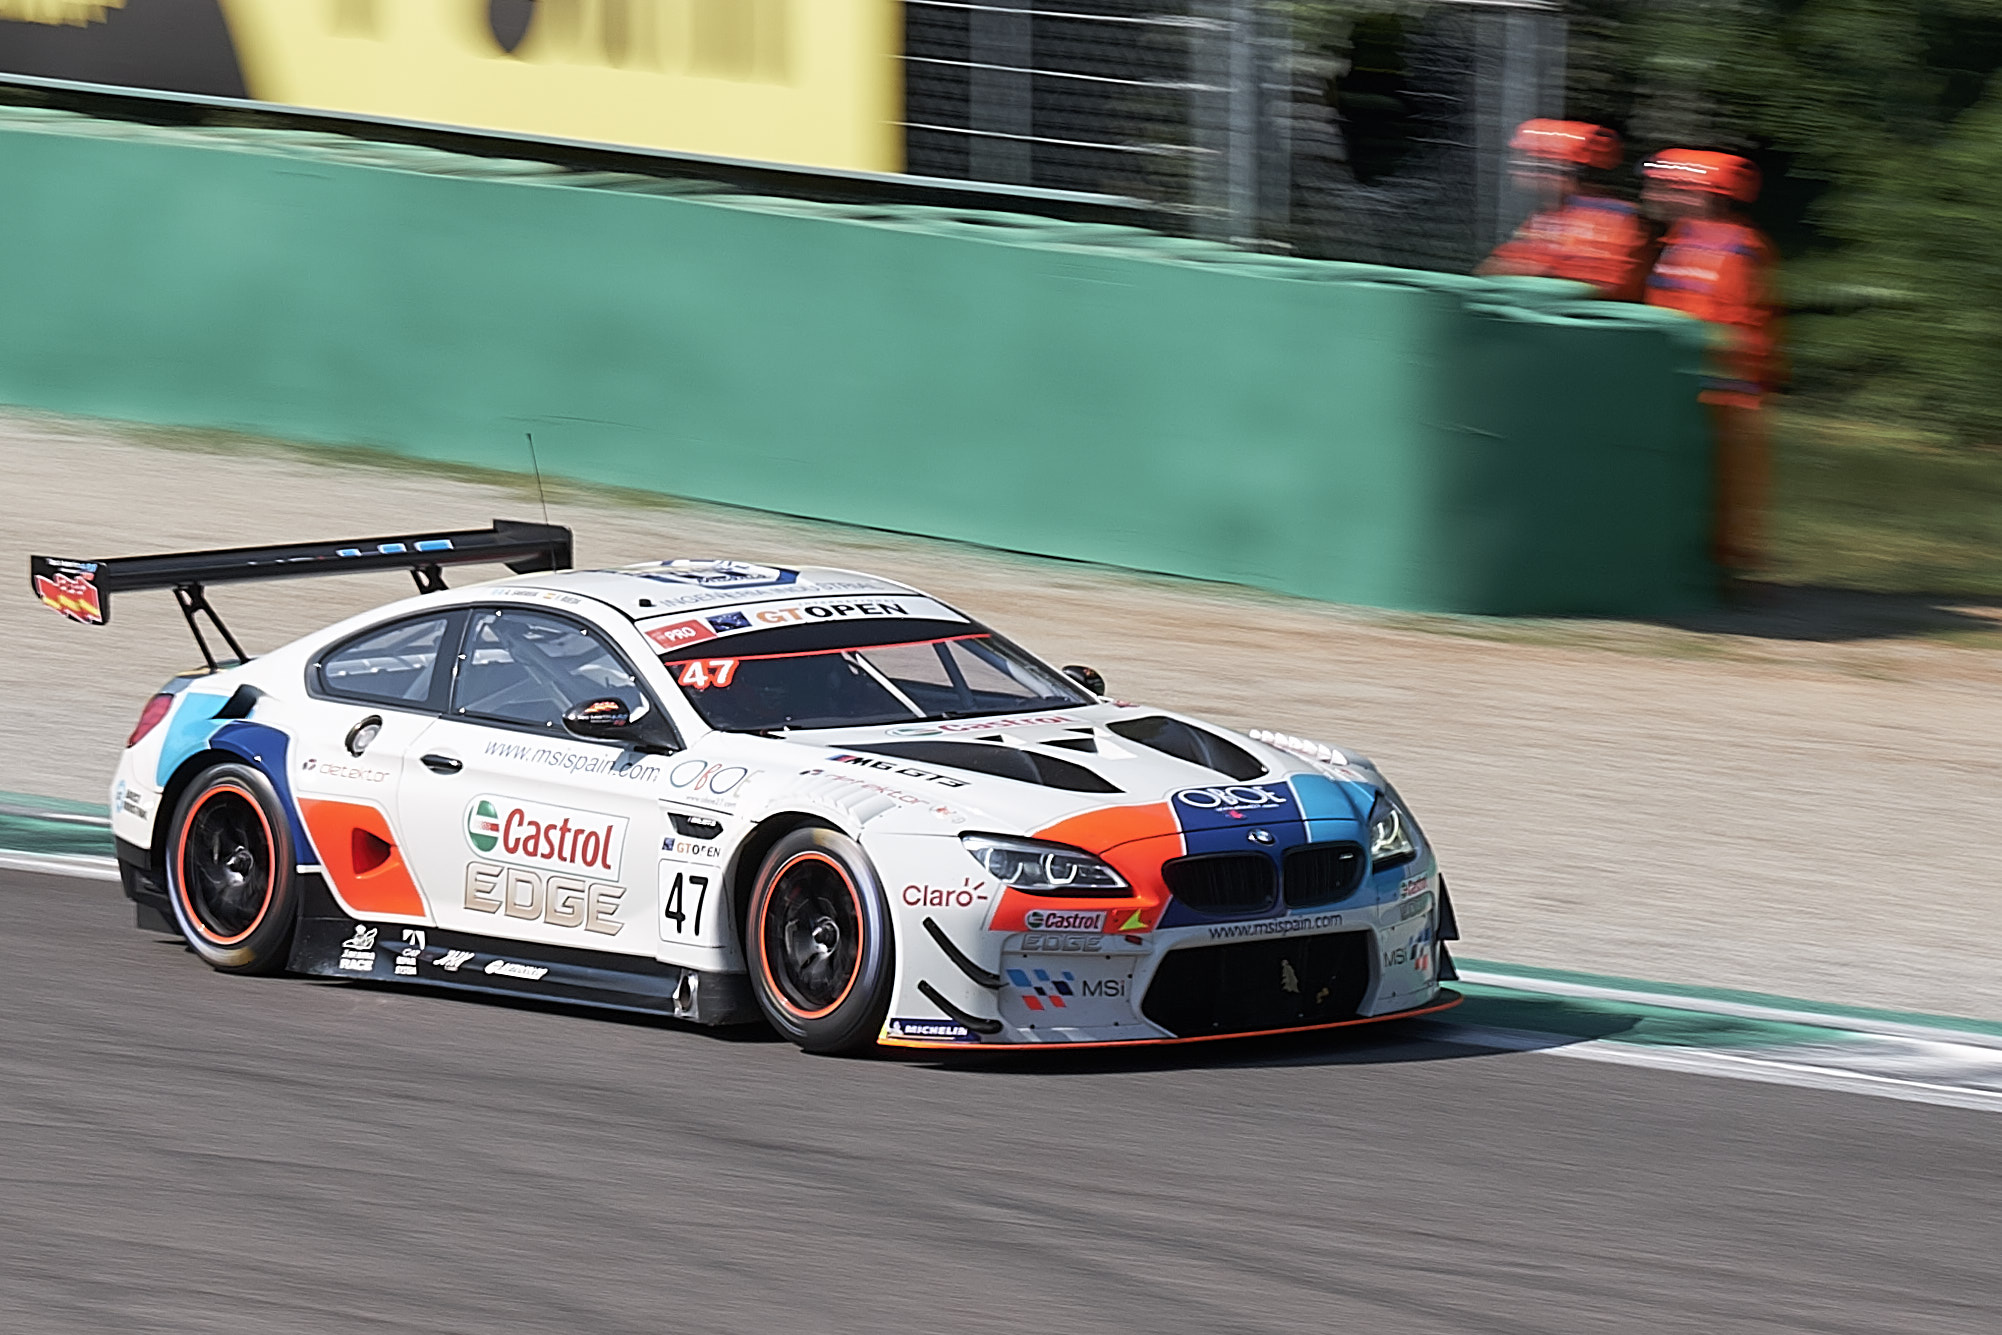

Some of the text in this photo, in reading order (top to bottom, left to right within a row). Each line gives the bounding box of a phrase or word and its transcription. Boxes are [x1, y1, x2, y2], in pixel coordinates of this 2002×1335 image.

[664, 626, 697, 642] PRO
[681, 660, 736, 688] 47
[938, 716, 1072, 731] Castrol
[484, 740, 661, 782] www.msispain.com
[845, 757, 972, 788] M6 GT3
[503, 808, 613, 870] Castrol
[464, 861, 627, 936] EDGE
[664, 872, 709, 936] 47
[903, 885, 973, 907] Claro
[1045, 912, 1101, 929] Castrol
[1208, 914, 1343, 939] www.msispain.com
[1021, 933, 1102, 952] EDGE
[1082, 980, 1125, 997] MSi
[904, 1025, 968, 1036] MICHELIN
